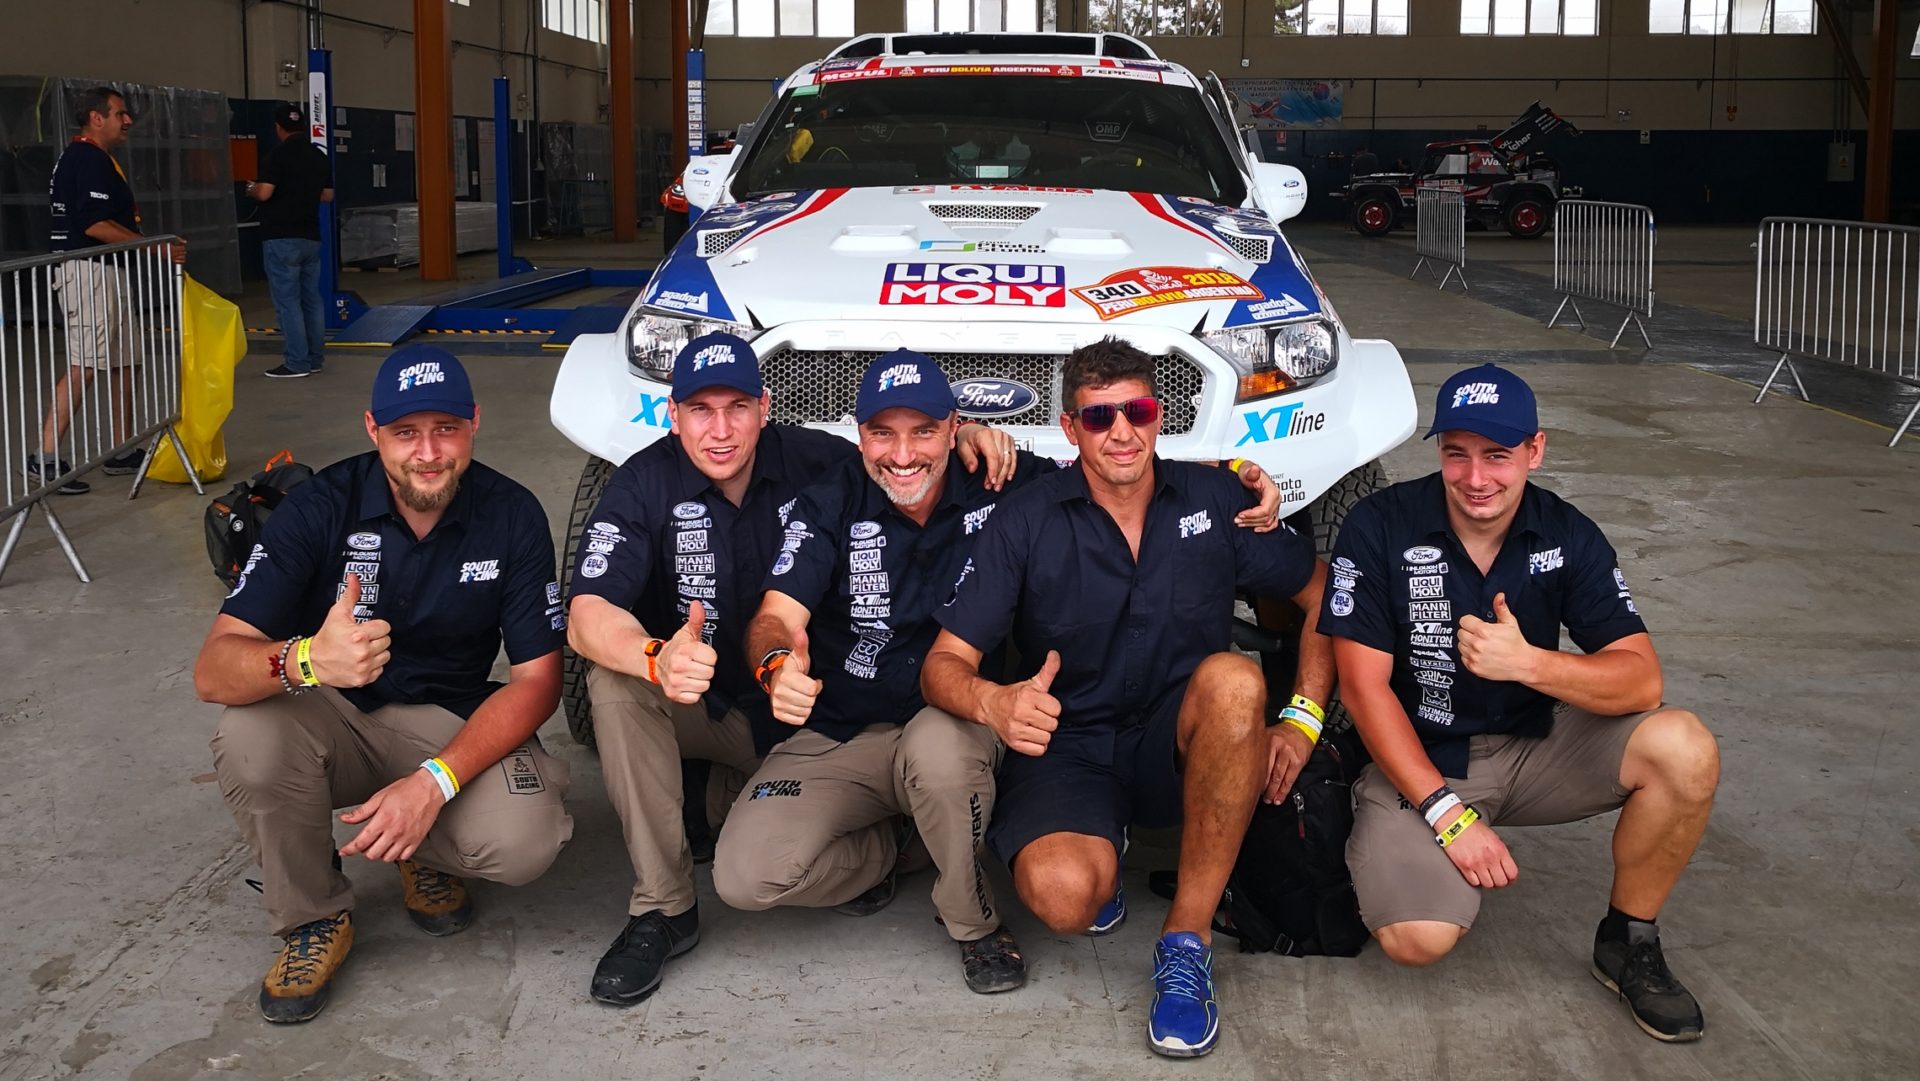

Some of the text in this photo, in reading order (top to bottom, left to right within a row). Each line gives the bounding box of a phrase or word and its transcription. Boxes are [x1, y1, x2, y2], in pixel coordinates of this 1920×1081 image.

[821, 68, 887, 82] MOTUL
[923, 65, 1051, 74] PERU BOLIVIA ARGENTINA
[1095, 124, 1120, 135] OMP
[892, 263, 1057, 284] LIQUI
[1183, 272, 1237, 287] 2018
[887, 284, 1063, 306] MOLY
[1088, 282, 1141, 300] 340
[1098, 286, 1254, 315] PERU BOLIVIA ARGENTINA
[1247, 298, 1290, 313] agados
[693, 344, 732, 363] SOUTH
[398, 362, 440, 381] SOUTH
[878, 363, 918, 383] SOUTH
[958, 383, 1015, 407] Ford
[1452, 382, 1498, 398] SOUTH
[1234, 401, 1325, 447] XTline
[353, 535, 378, 546] Ford
[680, 532, 705, 541] LIQUI
[589, 541, 615, 552] OMP
[680, 541, 706, 550] MOLY
[678, 556, 712, 564] MANN
[852, 552, 879, 561] LIQUI
[1411, 550, 1434, 560] Ford
[347, 564, 376, 573] LIQUI
[460, 559, 499, 572] SOUTH
[678, 564, 712, 572] FILTER
[852, 561, 880, 570] MOLY
[852, 575, 886, 584] MANN
[1411, 577, 1440, 587] LIQUI
[852, 583, 887, 592] FILTER
[1411, 587, 1441, 598] MOLY
[851, 605, 891, 615] HONITON
[1411, 602, 1448, 611] MANN
[1412, 610, 1449, 619] FILTER
[1410, 622, 1453, 634] XTline
[1410, 634, 1453, 645] HONITON
[1419, 670, 1447, 683] PRIM
[751, 780, 802, 793] SOUTH
